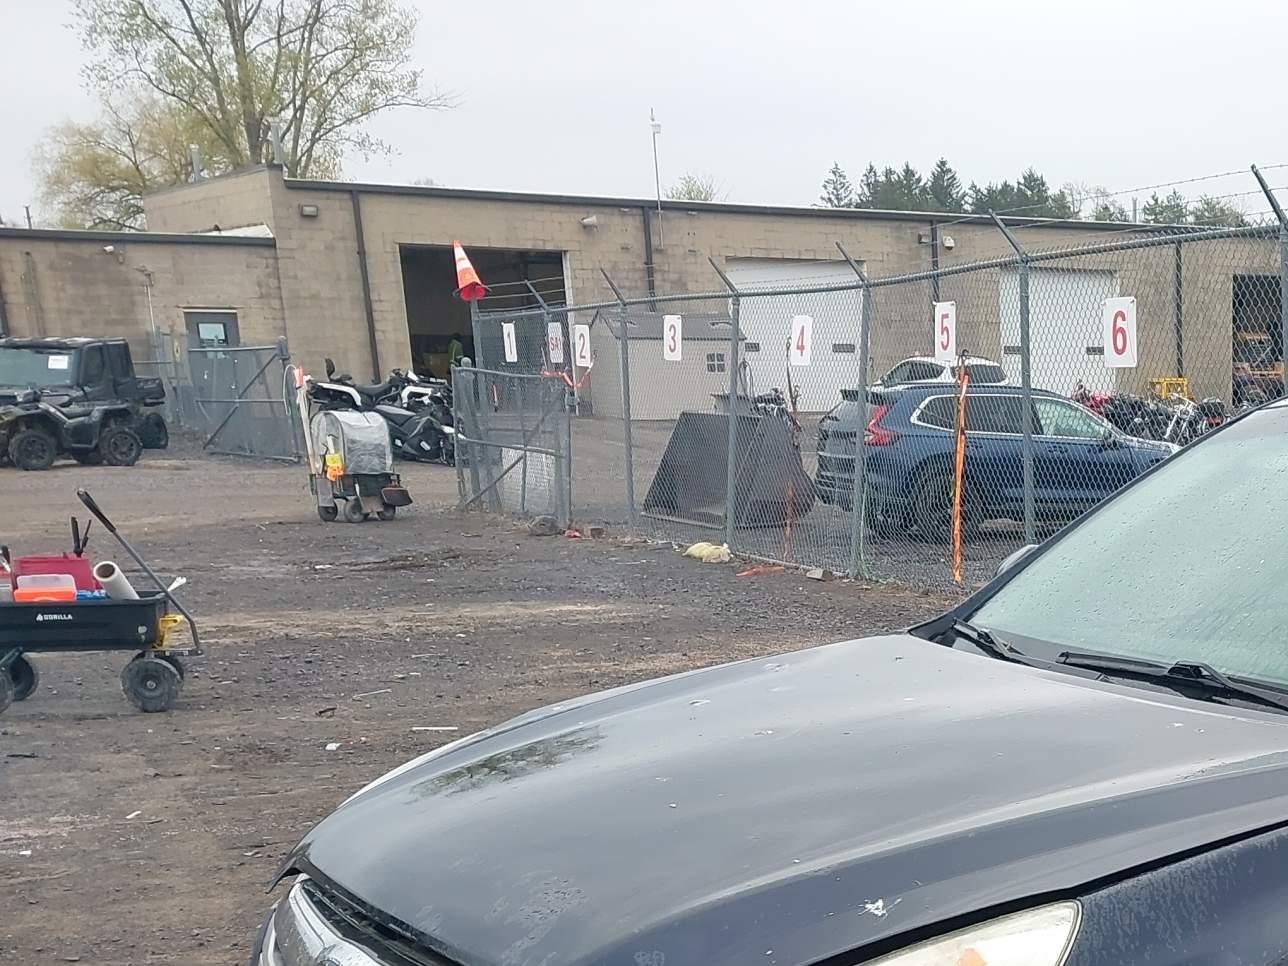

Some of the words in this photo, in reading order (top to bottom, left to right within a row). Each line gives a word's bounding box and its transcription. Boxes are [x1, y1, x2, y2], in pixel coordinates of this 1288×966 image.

[506, 331, 513, 355] 1
[578, 332, 587, 360] 2
[668, 323, 677, 353] 3
[796, 324, 806, 357] 4
[940, 312, 950, 351] 5
[1111, 310, 1127, 355] 6
